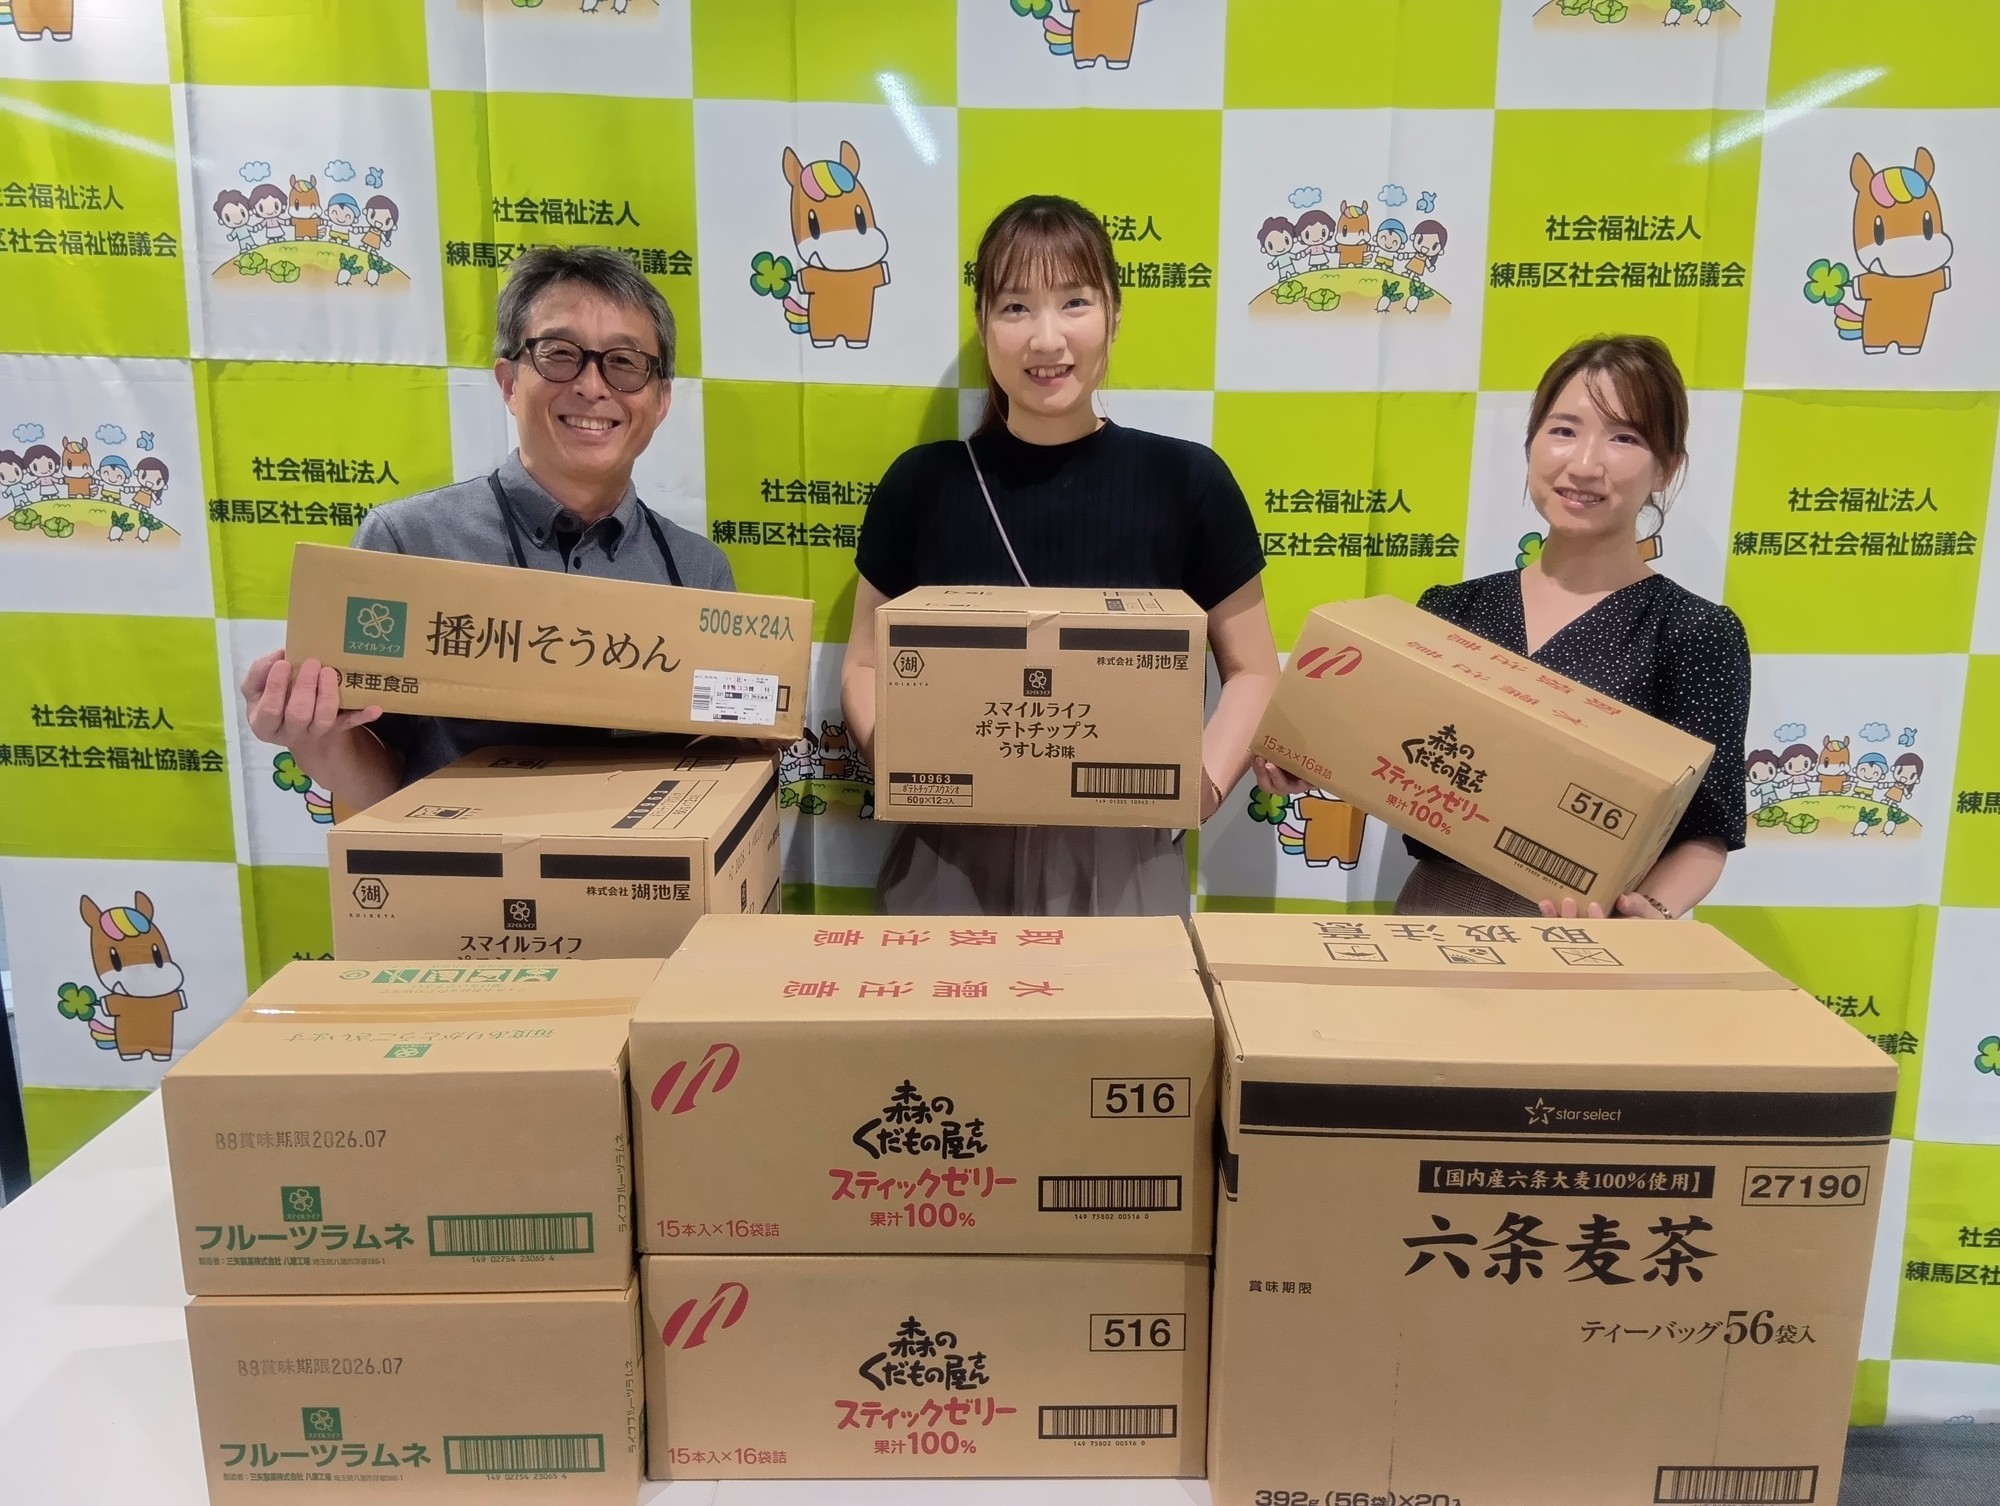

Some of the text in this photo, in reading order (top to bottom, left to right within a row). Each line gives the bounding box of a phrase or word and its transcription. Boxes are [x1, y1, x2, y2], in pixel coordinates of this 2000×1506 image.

[0, 182, 124, 210] 会福祉法人
[492, 197, 640, 227] 社会福祉法人
[1546, 215, 1702, 241] 社会福祉法人
[1490, 262, 1747, 289] 練馬区社会福祉協議会
[252, 457, 400, 485] 社会福祉法人
[1264, 489, 1411, 514] 社会福祉法人
[1788, 487, 1938, 512] 社会福祉法人
[712, 520, 864, 548] 練馬区社会福
[1258, 532, 1460, 558] 区社会福祉協議会
[1733, 531, 1977, 556] 練馬区社会福祉協議会
[699, 607, 795, 642] 500g×24入
[348, 641, 401, 653] スマイルライフ
[426, 611, 681, 673] 播州そうめん
[900, 656, 918, 673] 湖
[345, 672, 419, 694] 東亜食品
[31, 704, 174, 730] 社会福祉法人
[983, 702, 1091, 719] スマイルライフ
[975, 720, 1099, 739] ポテトチップス
[1428, 724, 1475, 760] 森の
[999, 742, 1076, 760] うすしお味
[1402, 737, 1489, 794] くだもの屋さん
[911, 774, 951, 784] 10963
[1370, 756, 1490, 826] スティックゼリー
[1385, 793, 1452, 837] 果汁100%
[1569, 791, 1623, 832] 516
[360, 885, 382, 903] 湖
[460, 935, 583, 954] スマイルライフ
[813, 929, 1065, 948] 取扱注意
[1312, 921, 1599, 944] 取扱注意
[782, 979, 1065, 1000] 水濡注意
[882, 1079, 955, 1124] 森の
[1105, 1083, 1176, 1114] 516
[853, 1118, 989, 1160] くだもの屋さん
[828, 1166, 1018, 1202] スティックゼリー
[1428, 1166, 1702, 1194] 【国内産六条大麦100%使用】
[1749, 1173, 1861, 1199] 27190
[869, 1203, 976, 1228] 果汁100%
[195, 1222, 415, 1252] フルーツラムネ
[656, 1219, 781, 1239] 15本入×16袋詰
[490, 1255, 516, 1263] 02754
[1402, 1211, 1719, 1286] 六条麦茶
[1248, 1279, 1312, 1295] 賞味期限
[888, 1316, 957, 1357] 森の
[1103, 1318, 1171, 1348] 516
[1581, 1310, 1816, 1346] ティーバッグ56袋入
[858, 1351, 991, 1391] くだもの屋さん
[834, 1397, 1018, 1431] スティックゼリー
[220, 1443, 432, 1468] フルーツラムネ
[874, 1430, 977, 1456] 果汁100%
[667, 1447, 788, 1466] 15本入×16袋詰
